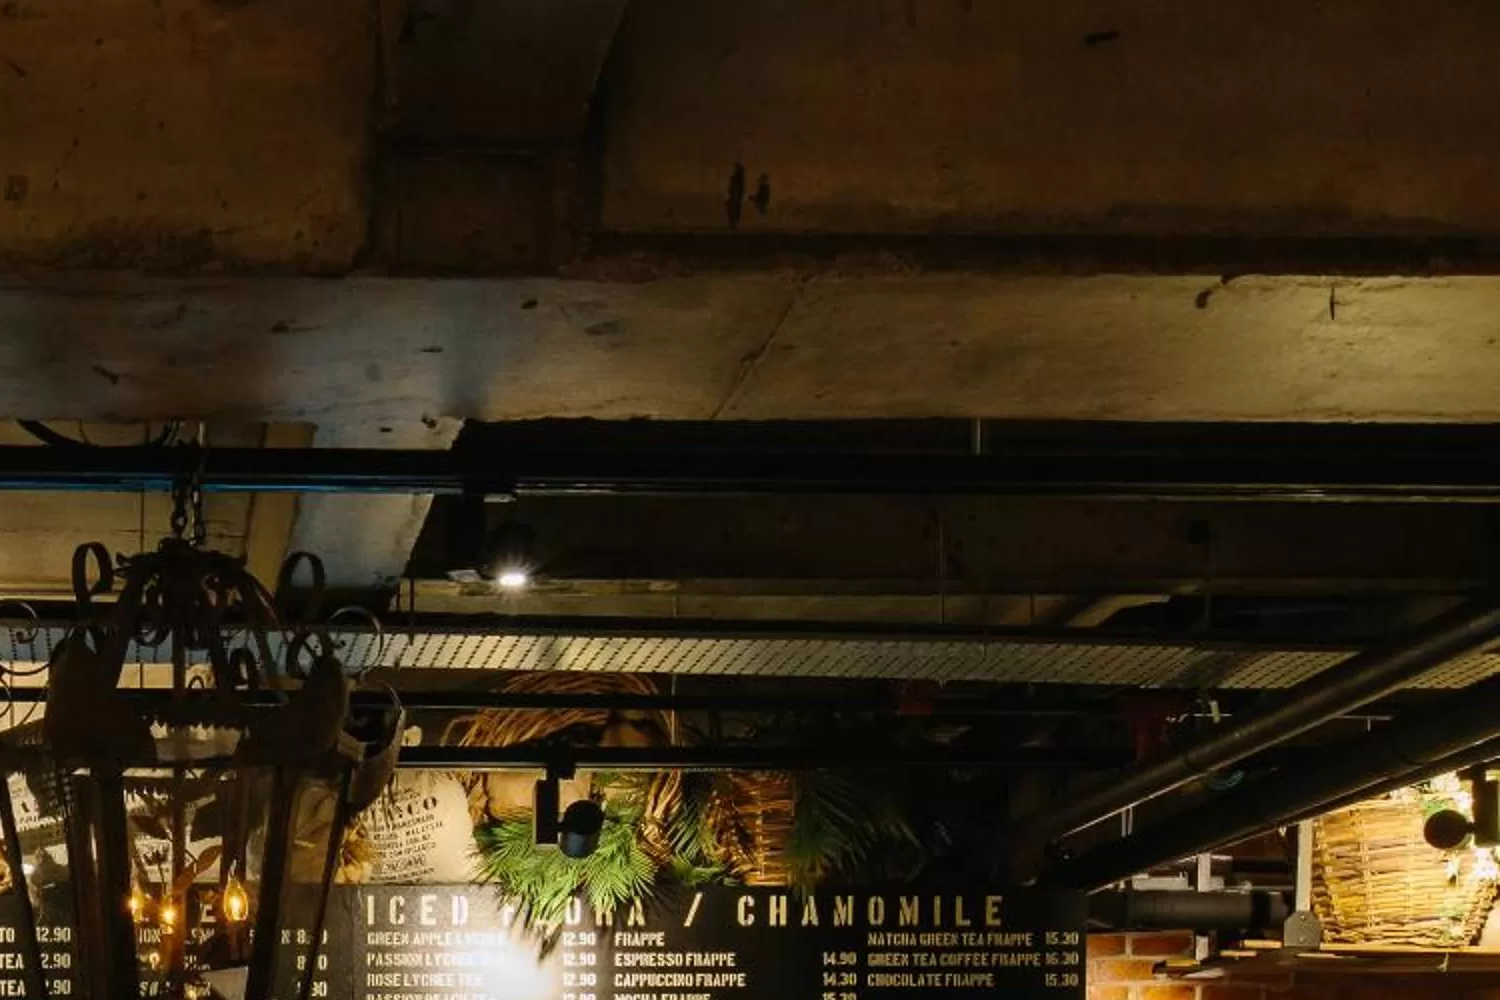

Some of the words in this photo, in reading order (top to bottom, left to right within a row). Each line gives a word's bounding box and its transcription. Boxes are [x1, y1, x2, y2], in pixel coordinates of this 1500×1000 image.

[367, 895, 469, 926] ICED
[504, 895, 646, 926] FOA
[683, 892, 703, 927] /
[737, 895, 1003, 926] CHAMOMILE
[367, 932, 409, 946] GREEN
[412, 932, 453, 946] APPLE
[563, 932, 596, 946] 12.90
[615, 932, 665, 946] FRAPPE
[867, 933, 916, 947] MATCHA
[919, 933, 959, 947] GREEN
[961, 933, 984, 947] TEA
[987, 933, 1033, 947] FRAPPE
[1045, 933, 1078, 947] 15.30
[40, 953, 71, 969] 2.90
[367, 953, 422, 967] PASSION
[563, 953, 596, 967] 12.90
[614, 953, 684, 966] ESPRESSO
[686, 953, 736, 966] FRAPPE
[823, 953, 857, 966] 14.90
[867, 952, 909, 967] GREEN
[911, 952, 936, 967] TEA
[940, 952, 989, 967] COFFEE
[991, 952, 1041, 967] FRAPPE
[1045, 952, 1078, 967] 16.30
[367, 973, 401, 987] ROSE
[563, 973, 596, 987] 12.90
[615, 973, 694, 987] CAPPUCCINO
[696, 973, 745, 987] FRAPPE
[823, 973, 857, 987] 14.30
[867, 973, 942, 987] CHOCOLATE
[945, 973, 995, 987] FRAPPE
[1045, 973, 1078, 987] 15.30
